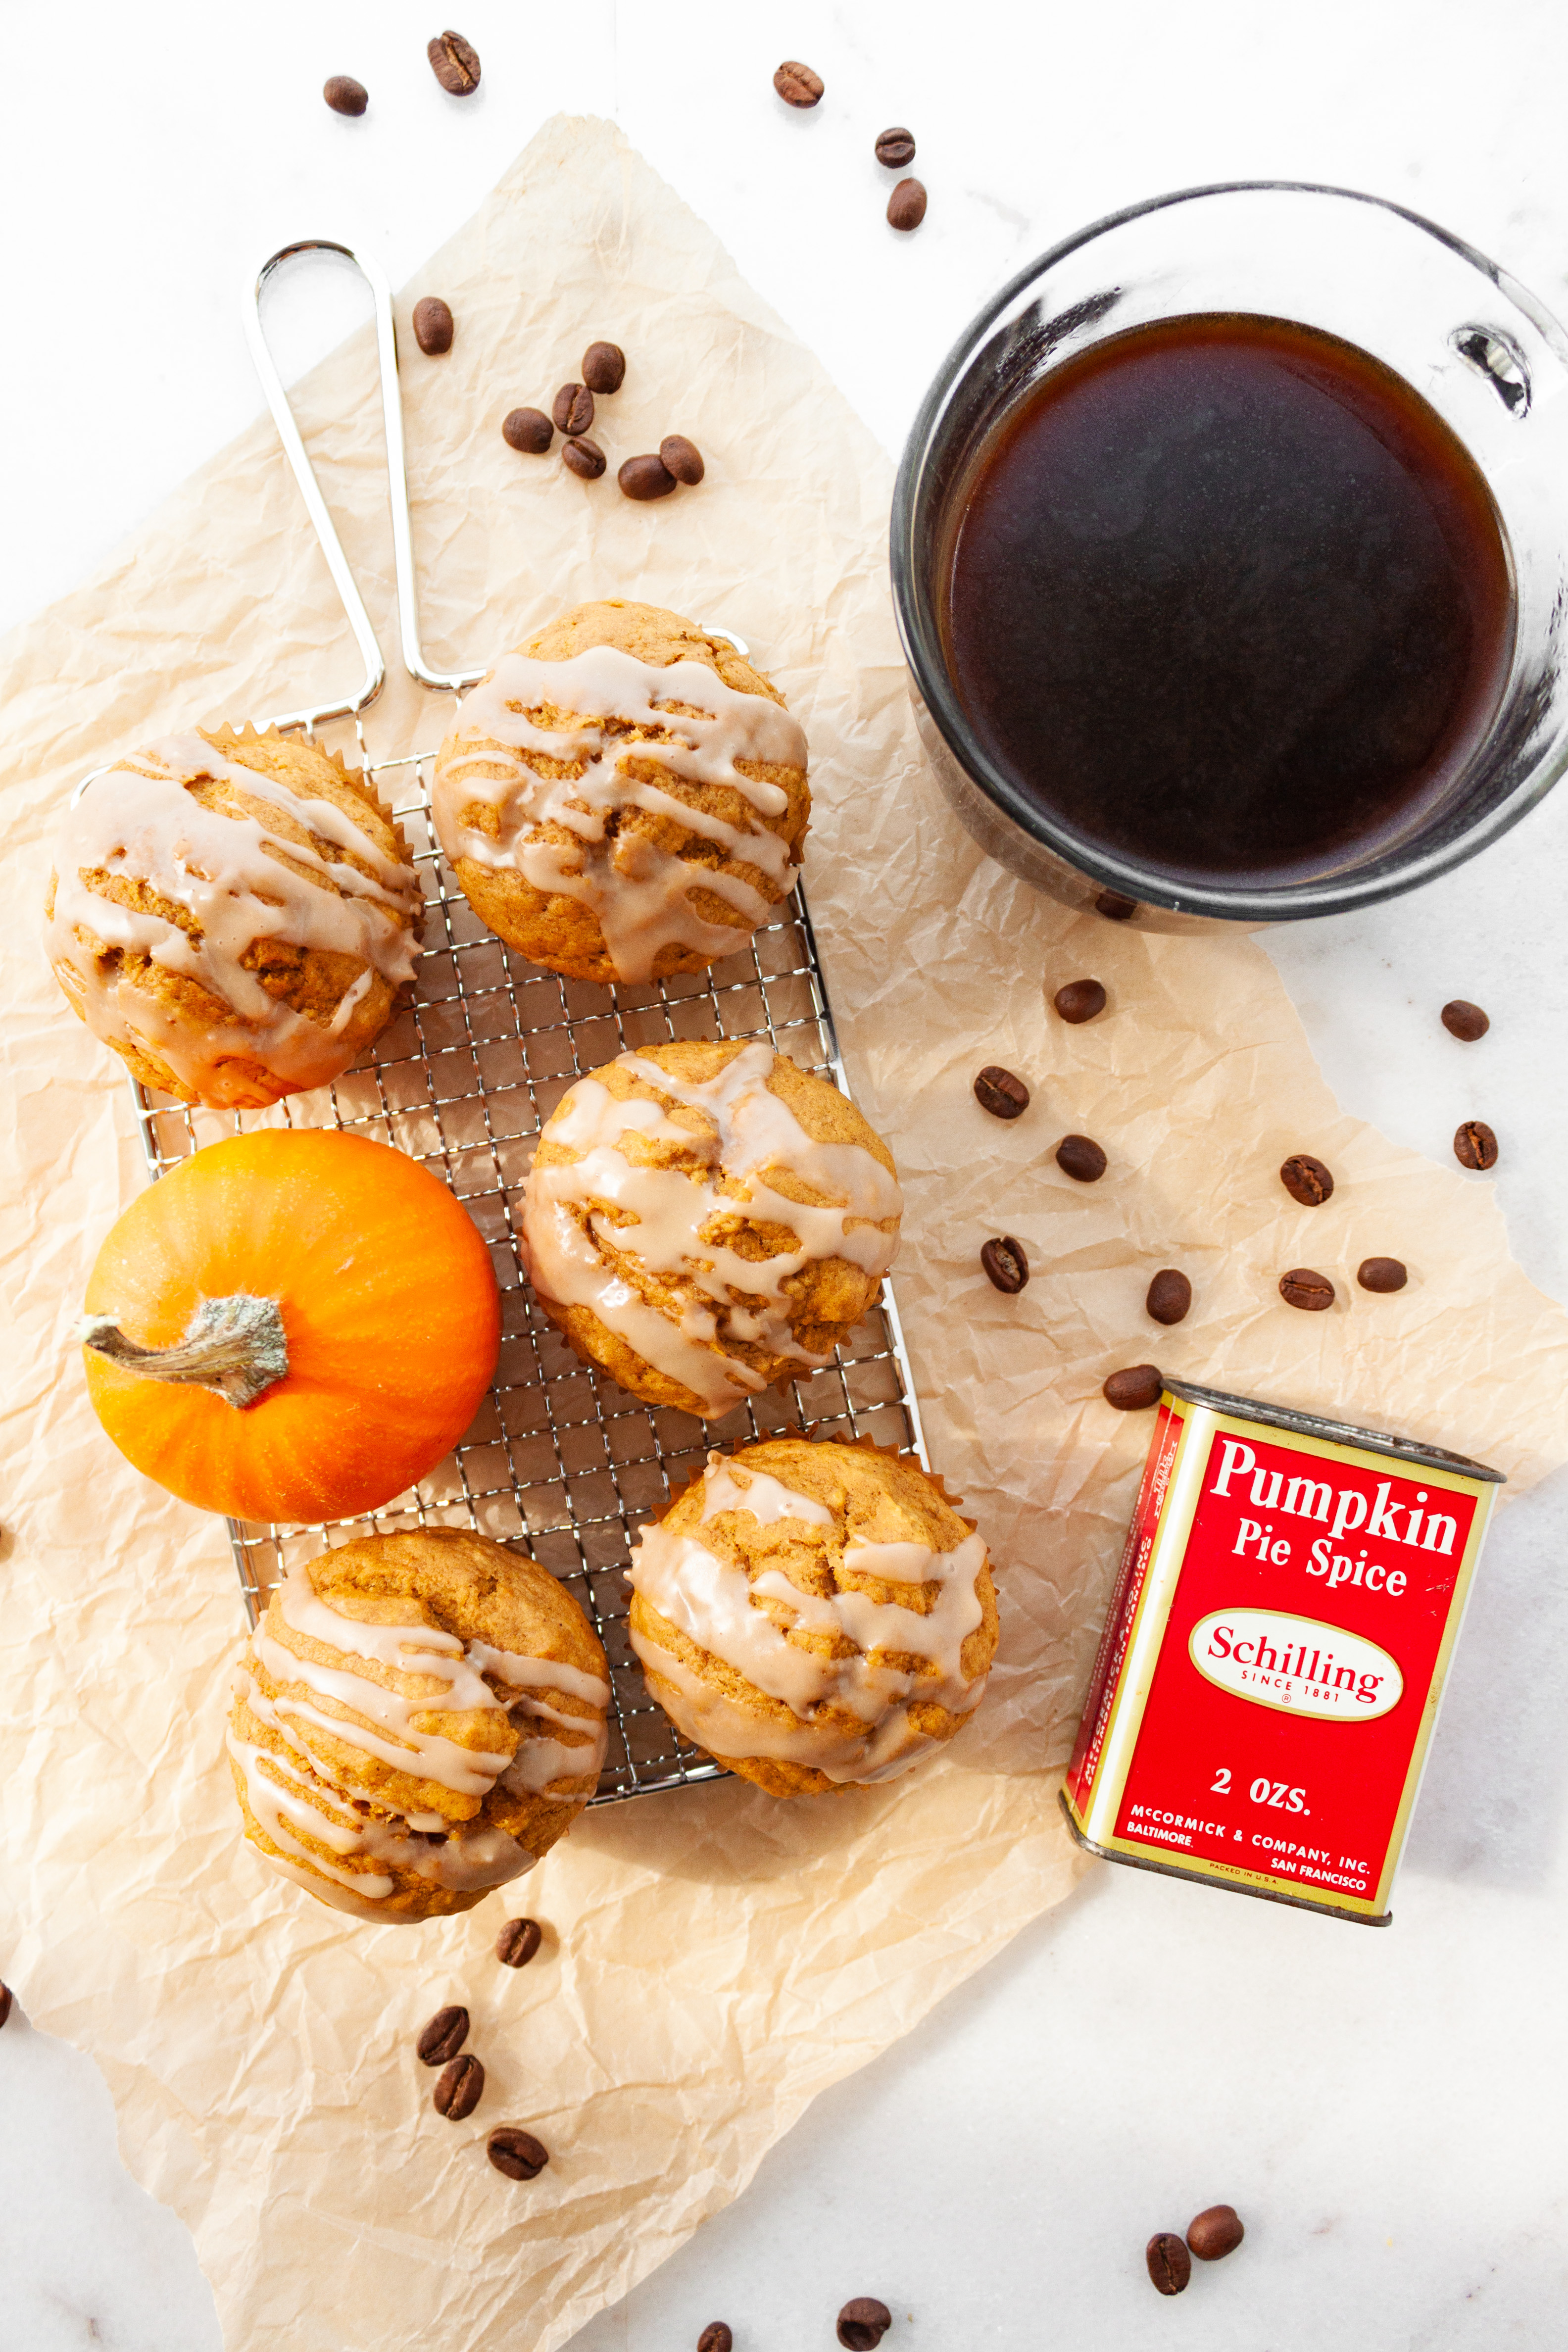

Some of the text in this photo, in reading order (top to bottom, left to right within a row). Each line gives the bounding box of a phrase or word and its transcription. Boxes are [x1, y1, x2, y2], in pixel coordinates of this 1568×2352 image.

[1210, 1439, 1457, 1556] Pumpkin
[1124, 1583, 1136, 1618] CO.
[1134, 1534, 1148, 1578] INC.
[1125, 1536, 1152, 1634] FRANCISCO
[1231, 1518, 1407, 1596] Pie Spice
[1208, 1626, 1384, 1704] Schilling
[1241, 1670, 1339, 1702] SINCE 1881
[1210, 1768, 1311, 1816] 2 OZS.
[1210, 1863, 1240, 1875] PACKED
[1233, 1829, 1243, 1842] &
[1252, 1834, 1330, 1865] COMPANY,
[1339, 1856, 1371, 1875] INC.
[1271, 1858, 1366, 1891] SAN FRANCISCO
